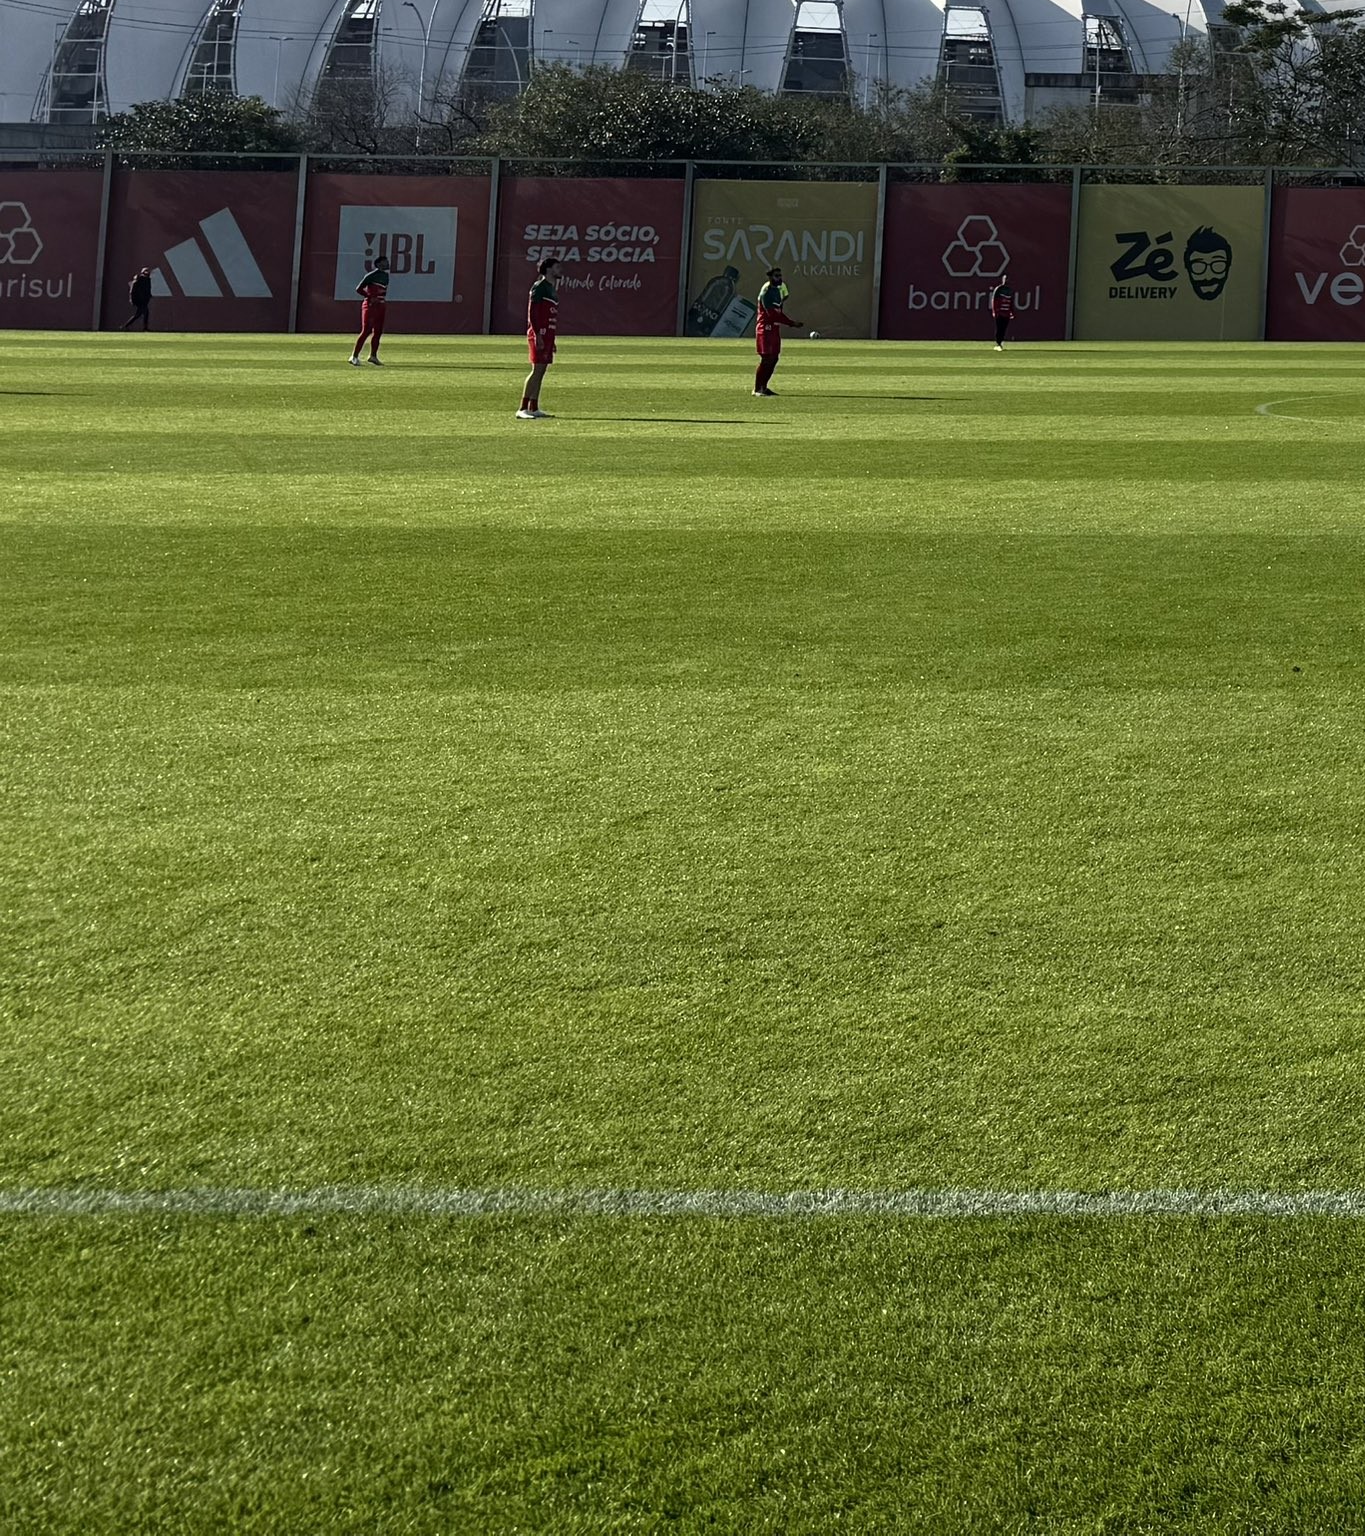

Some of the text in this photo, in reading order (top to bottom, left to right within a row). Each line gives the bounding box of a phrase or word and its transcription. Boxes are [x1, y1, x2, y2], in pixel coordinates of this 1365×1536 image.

[523, 221, 661, 245] SEJA SÓCIO,
[364, 233, 435, 274] JBL
[526, 243, 655, 263] SEJA SÓCIA
[703, 225, 864, 271] SARANDI
[1110, 231, 1179, 282] Zé
[599, 273, 642, 291] Colorado
[793, 265, 860, 276] ALKALINE
[908, 284, 1040, 310] banriul
[1109, 287, 1177, 299] DELIVERY
